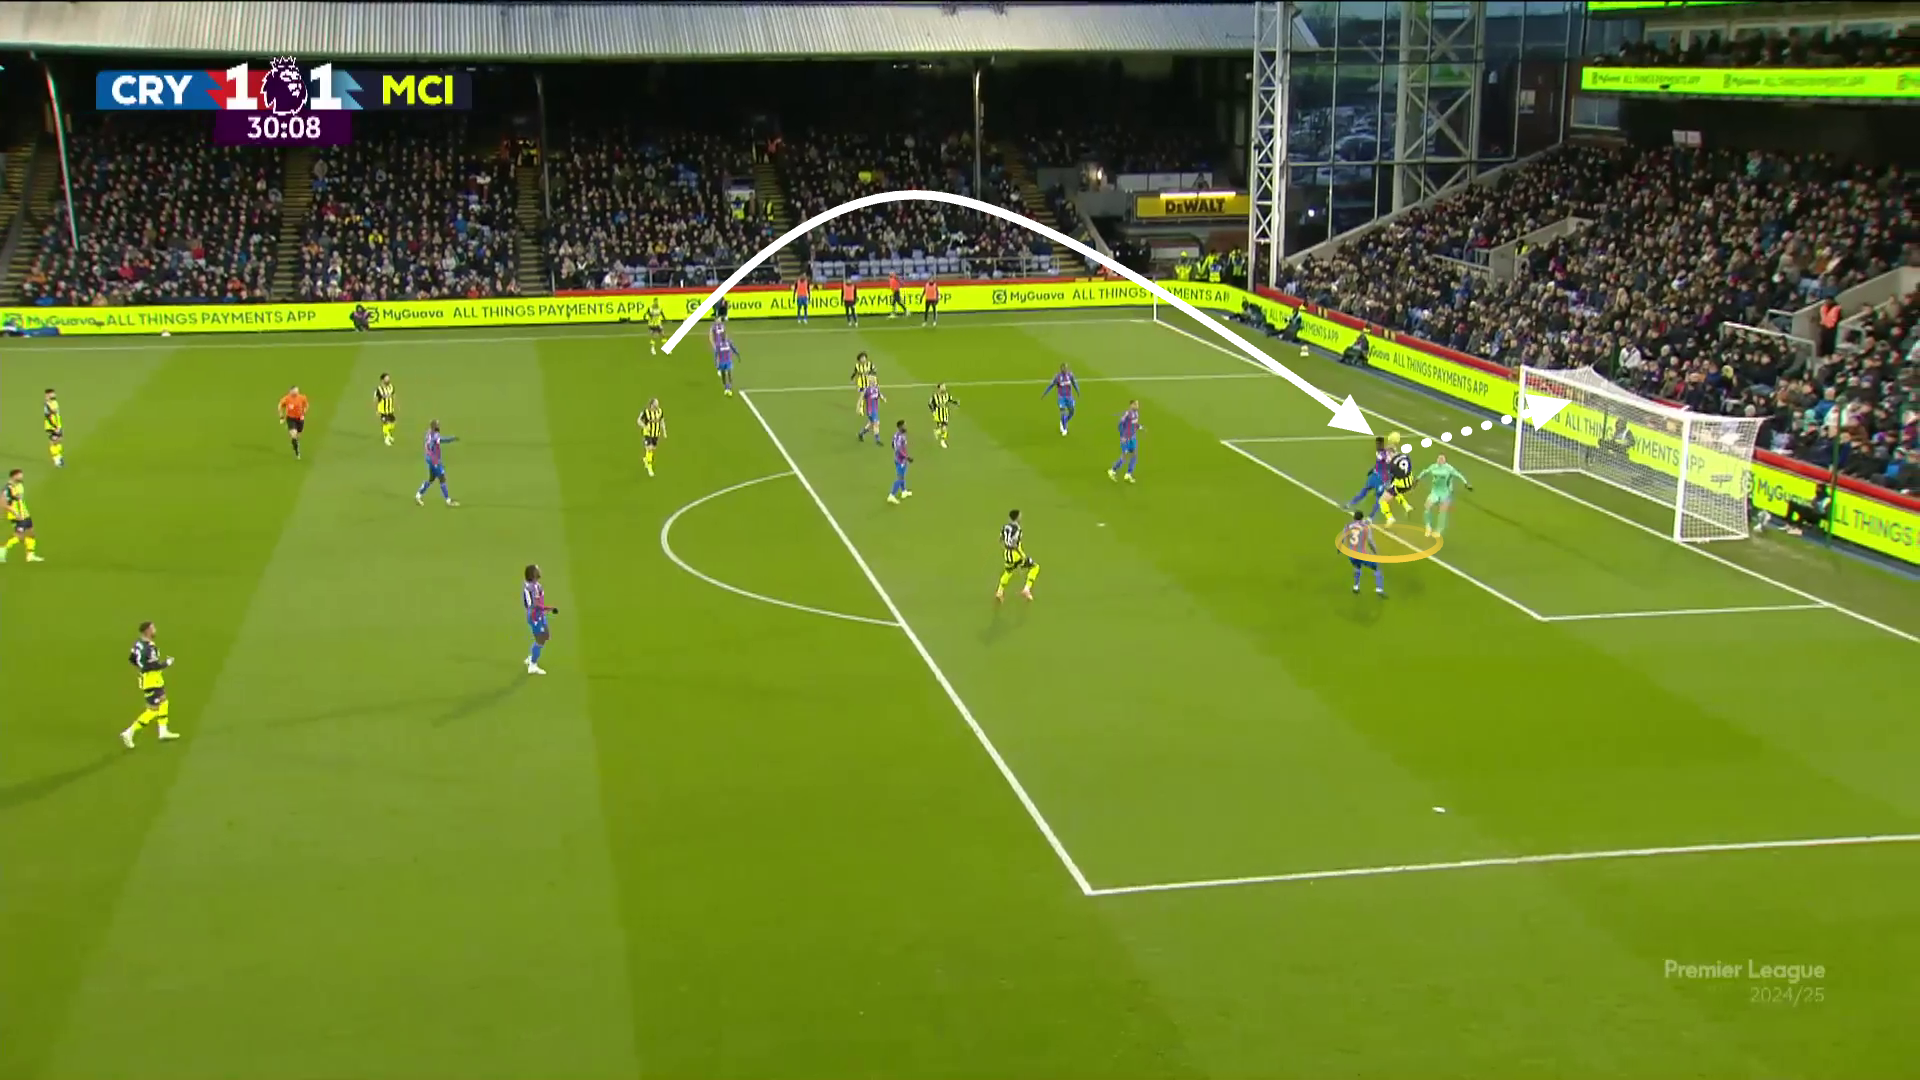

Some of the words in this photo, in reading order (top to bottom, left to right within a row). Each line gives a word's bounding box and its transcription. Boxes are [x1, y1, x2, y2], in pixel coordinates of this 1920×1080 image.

[770, 297, 795, 310] ALL
[1010, 290, 1064, 303] MyGuava
[1072, 288, 1096, 300] ALL
[1098, 287, 1147, 300] THINGS
[107, 313, 135, 326] ALL
[139, 312, 198, 326] THINGS
[201, 311, 283, 324] PAYMENTS
[287, 309, 317, 322] APP
[383, 308, 444, 321] MyGuava
[453, 307, 479, 319] ALL
[482, 304, 535, 318] THINGS
[539, 302, 614, 317] PAYMENTS
[617, 301, 645, 314] APP
[1393, 352, 1406, 368] ALL
[1407, 355, 1432, 378] THINGS
[1433, 365, 1472, 393] PAYMENTS
[1473, 380, 1489, 397] APP
[1565, 412, 1581, 432] ALL
[1399, 457, 1409, 475] 9
[1350, 528, 1361, 545] 3
